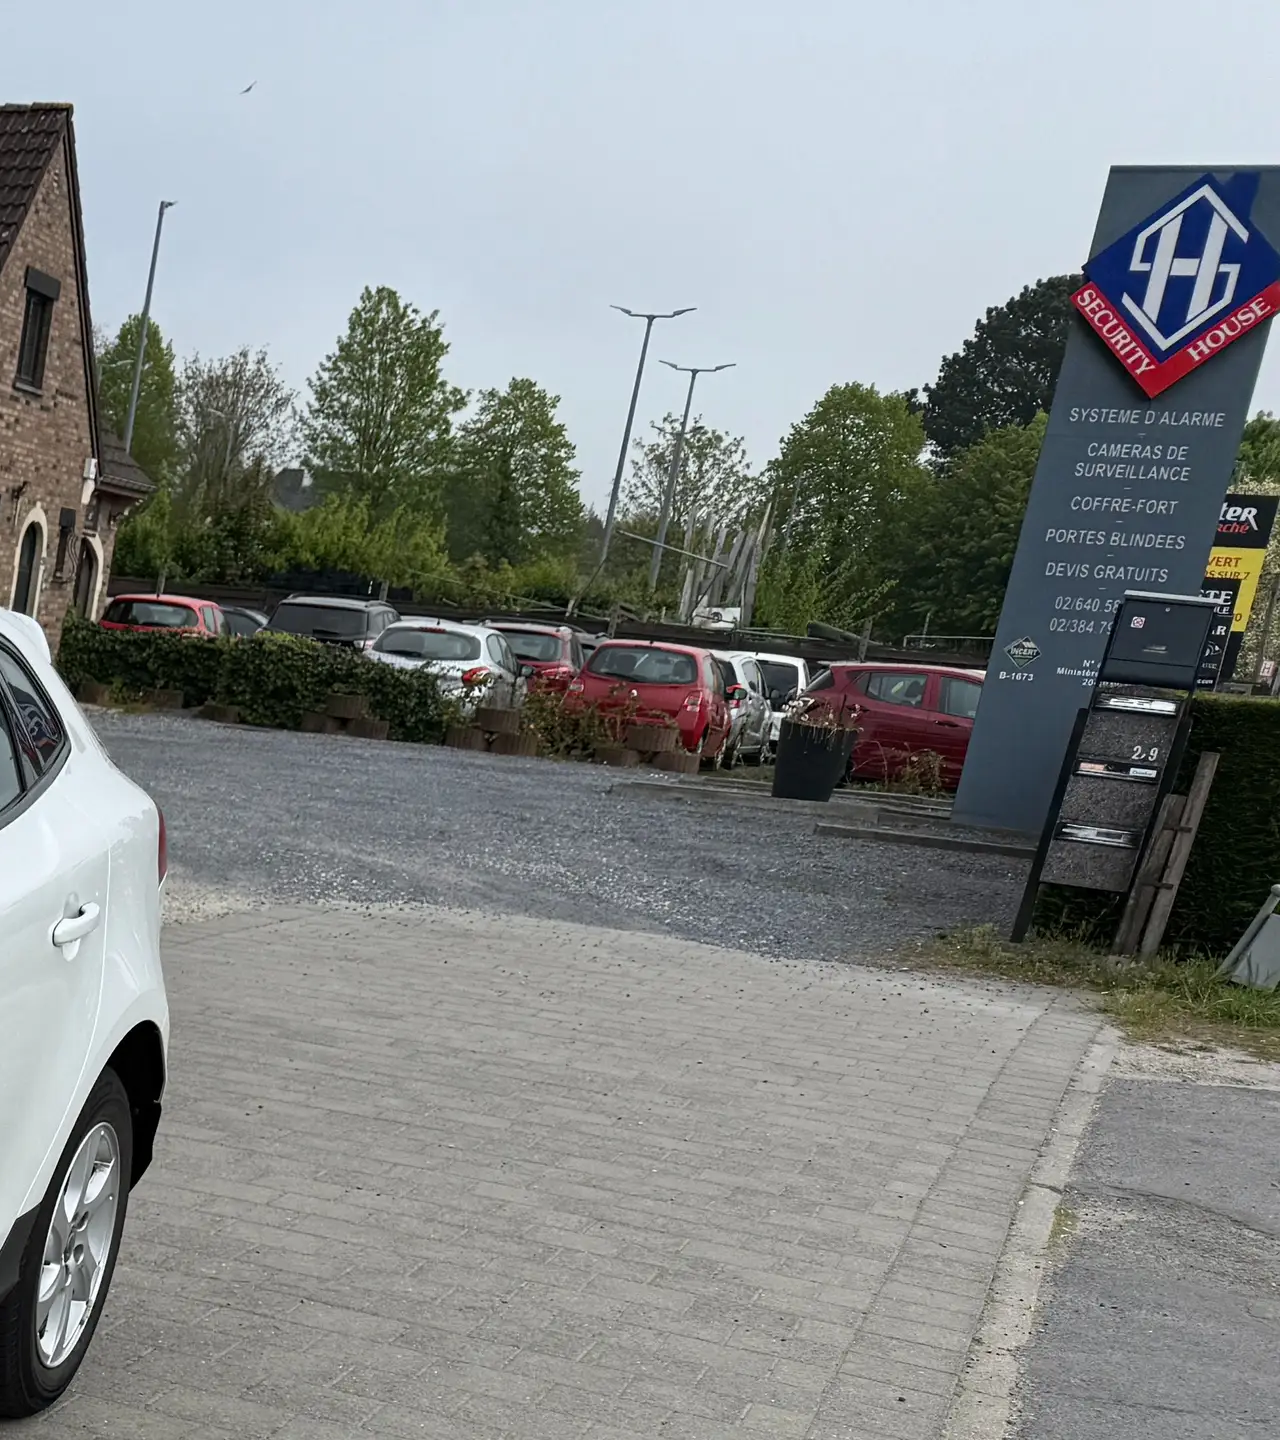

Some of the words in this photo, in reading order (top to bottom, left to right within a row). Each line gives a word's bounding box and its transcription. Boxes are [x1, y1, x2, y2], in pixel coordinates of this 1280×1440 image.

[1077, 289, 1155, 376] SECURITY
[1187, 296, 1272, 362] HOUSE
[1069, 407, 1142, 424] SYSTEME
[1144, 410, 1225, 427] D'ALARME
[1087, 442, 1162, 459] CAMERAS
[1167, 445, 1189, 460] DE
[1074, 462, 1191, 481] SURVEILLANCE
[1070, 496, 1179, 514] COFFRE-FORT
[1045, 528, 1106, 545] PORTES
[1109, 531, 1186, 550] BLINDEES
[1208, 556, 1243, 568] VERT
[1045, 562, 1089, 578] DEVIS
[1093, 564, 1169, 582] GRATUITS
[1054, 596, 1121, 614] 02/640.58
[1049, 617, 1114, 635] 02/384.79
